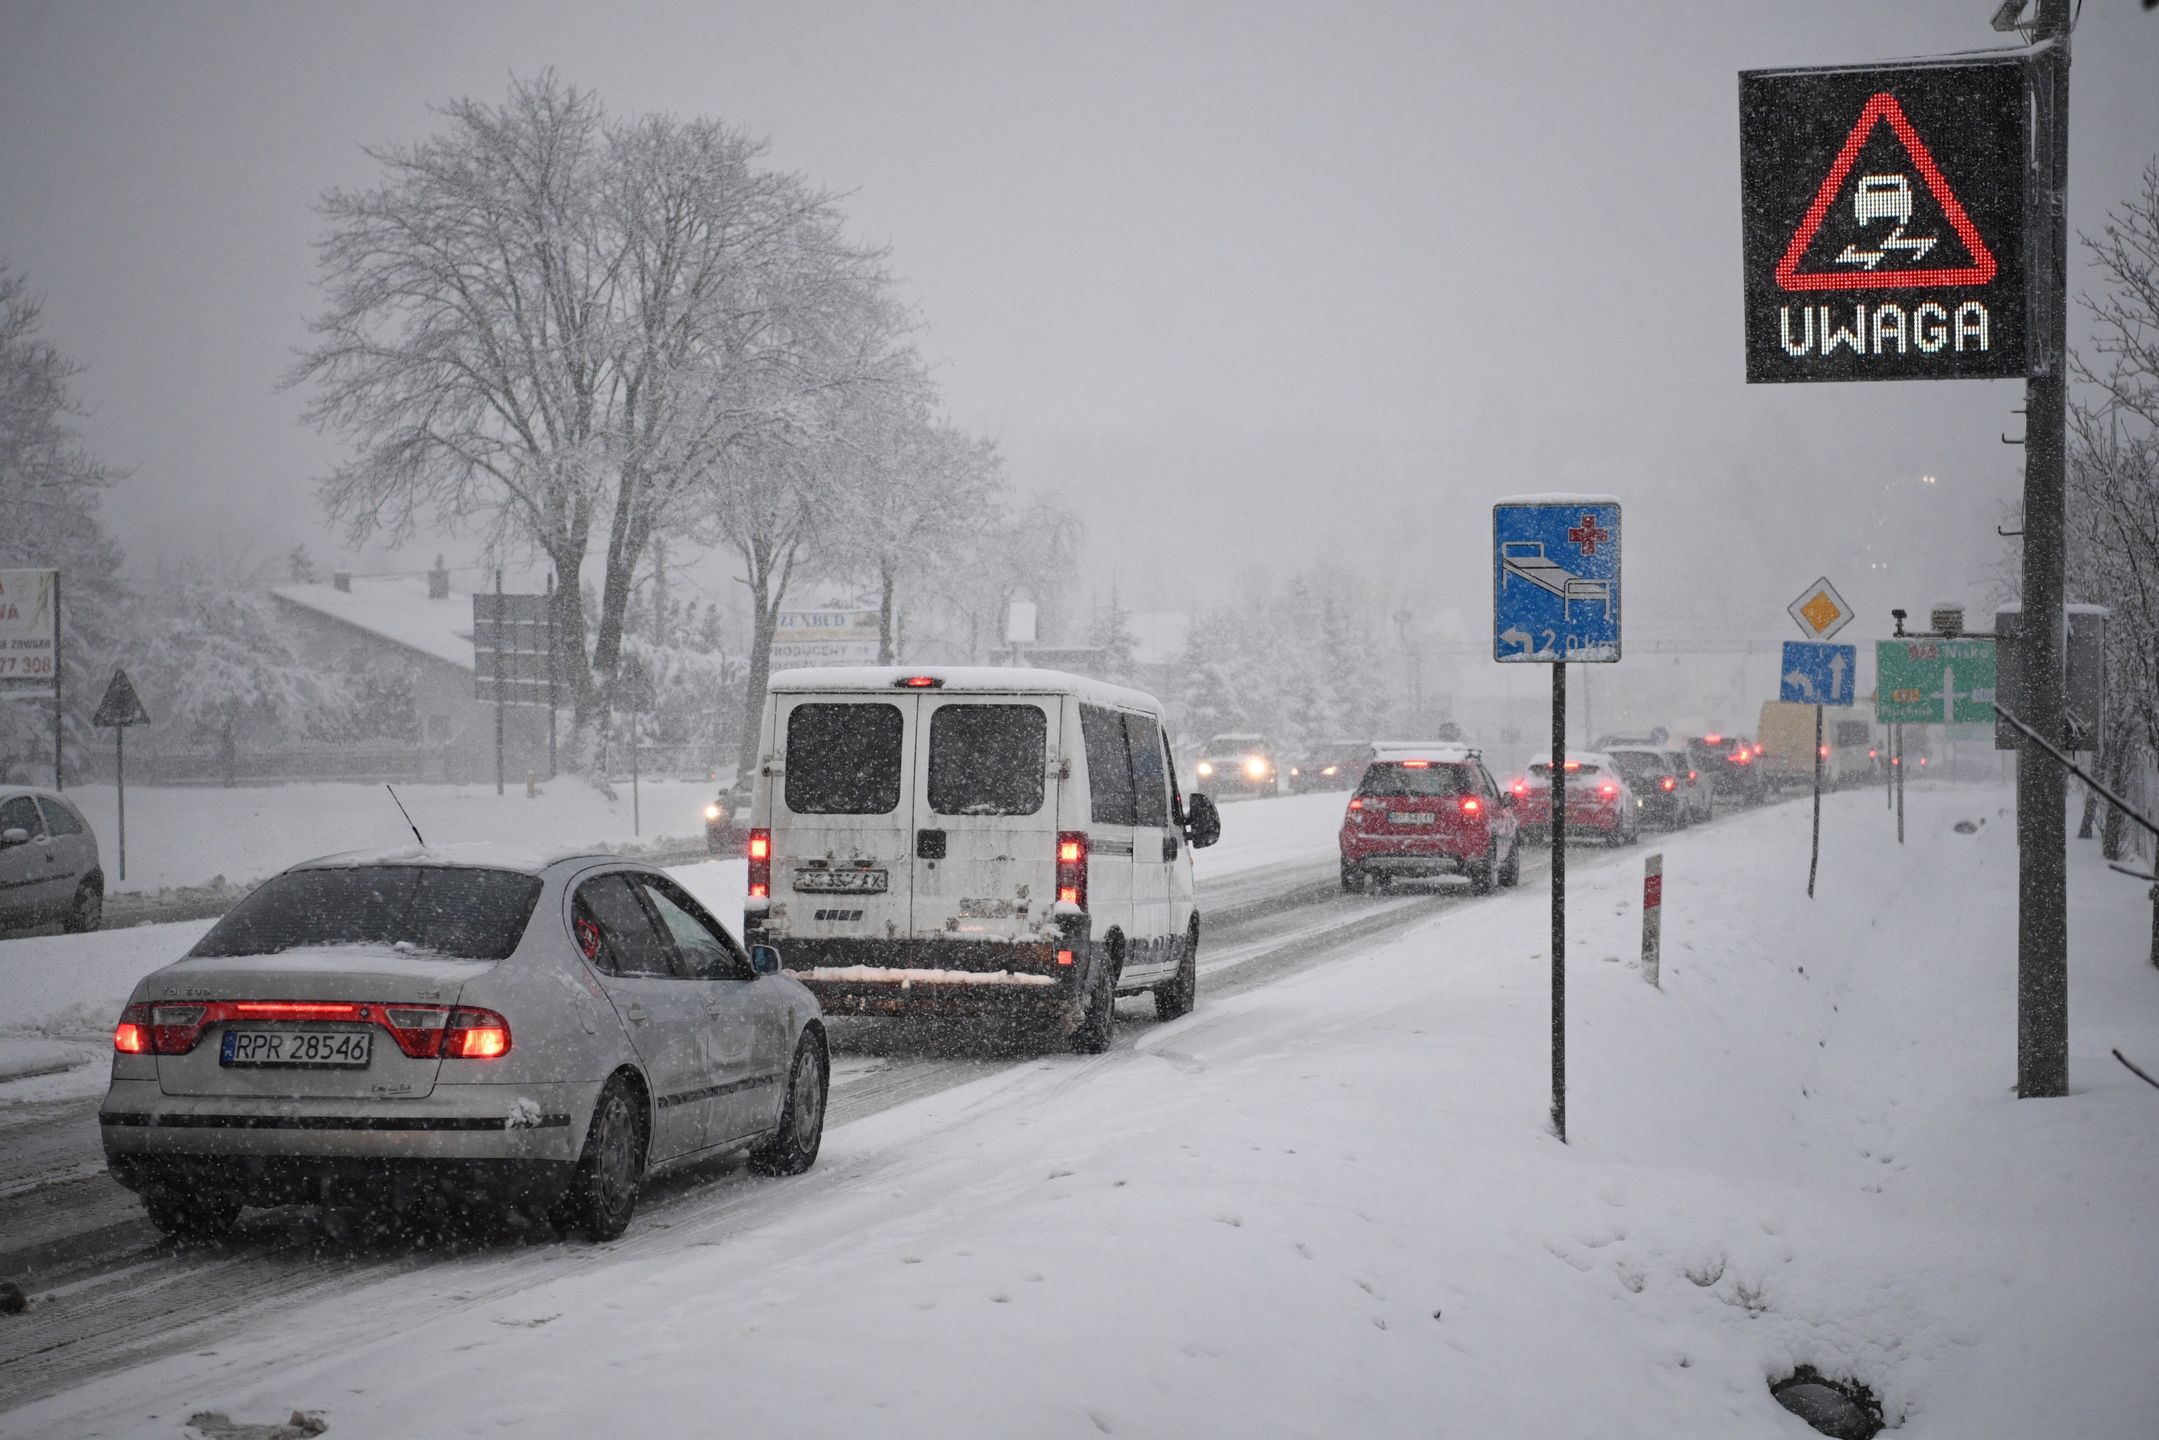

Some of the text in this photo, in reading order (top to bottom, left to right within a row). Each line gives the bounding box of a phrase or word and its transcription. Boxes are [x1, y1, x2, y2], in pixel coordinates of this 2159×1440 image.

[1780, 301, 1989, 356] UWAGA
[23, 656, 52, 674] 308
[235, 1034, 366, 1061] RPR 28546
